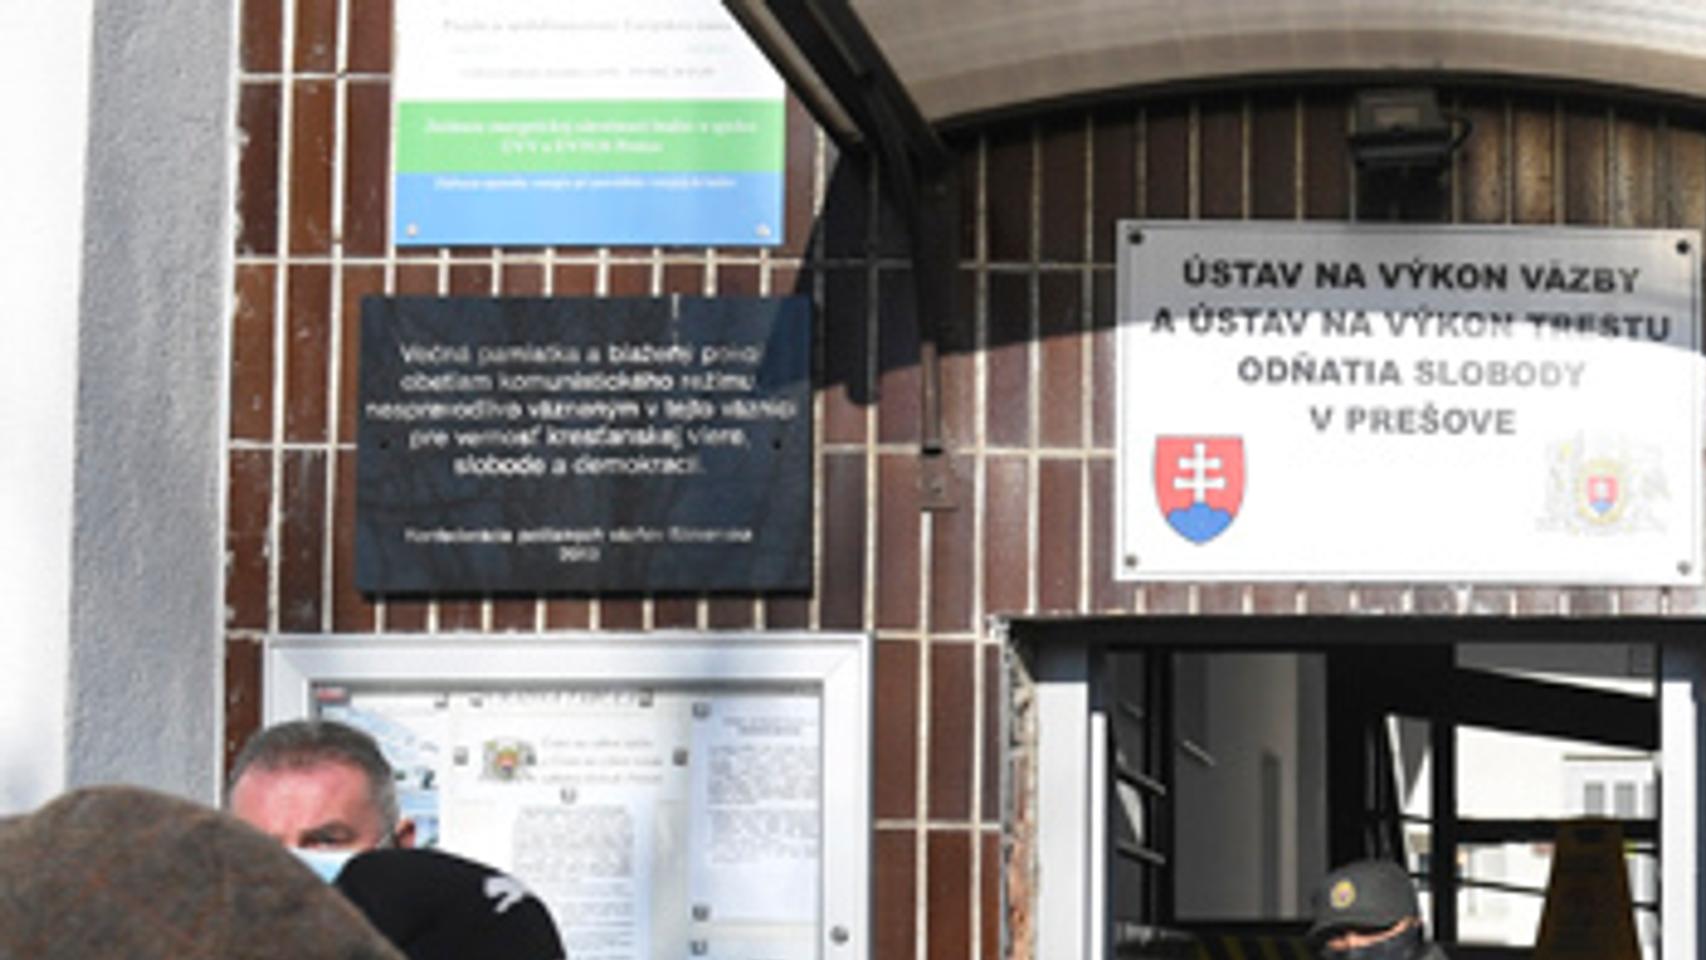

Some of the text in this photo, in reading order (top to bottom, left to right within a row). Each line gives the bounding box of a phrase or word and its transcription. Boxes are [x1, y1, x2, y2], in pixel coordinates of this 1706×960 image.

[1183, 253, 1303, 289] ÚSTAV
[1315, 262, 1367, 290] NA
[1378, 257, 1508, 291] VÝKON
[1150, 301, 1671, 343] A ÚSTAV NA VÝKON TRESTU
[585, 349, 600, 364] a
[1237, 350, 1586, 389] ODŇATIA SLOBODY
[400, 372, 494, 392] obetiam
[644, 404, 659, 418] v
[1309, 401, 1516, 437] V PREŠOVE
[410, 430, 450, 450] pre
[453, 454, 546, 476] slobode
[551, 458, 567, 475] a
